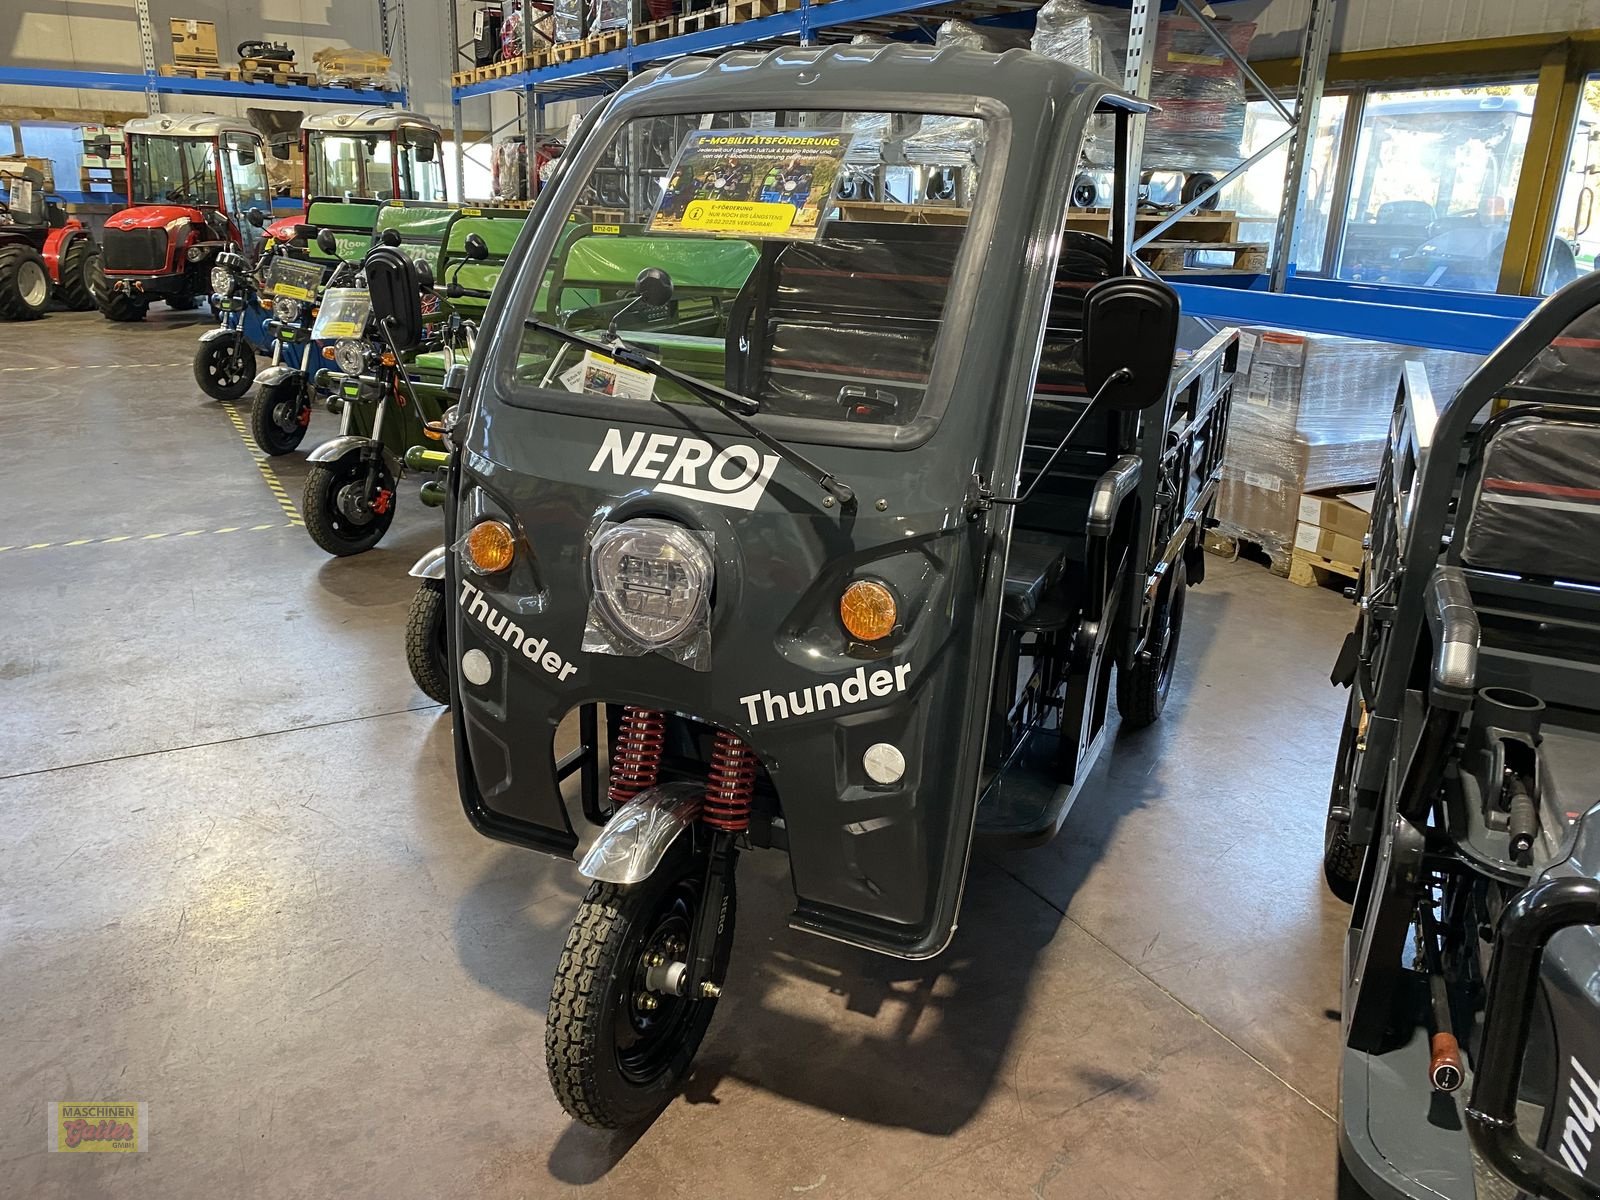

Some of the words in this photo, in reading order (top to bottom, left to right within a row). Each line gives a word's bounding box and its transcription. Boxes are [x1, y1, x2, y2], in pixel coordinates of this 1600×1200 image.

[698, 135, 840, 146] E-MOBILITÄTSFÖRDERUNG
[588, 428, 760, 491] NERO
[460, 578, 578, 682] Thunder
[739, 662, 912, 726] Thunder
[717, 895, 729, 935] NERO
